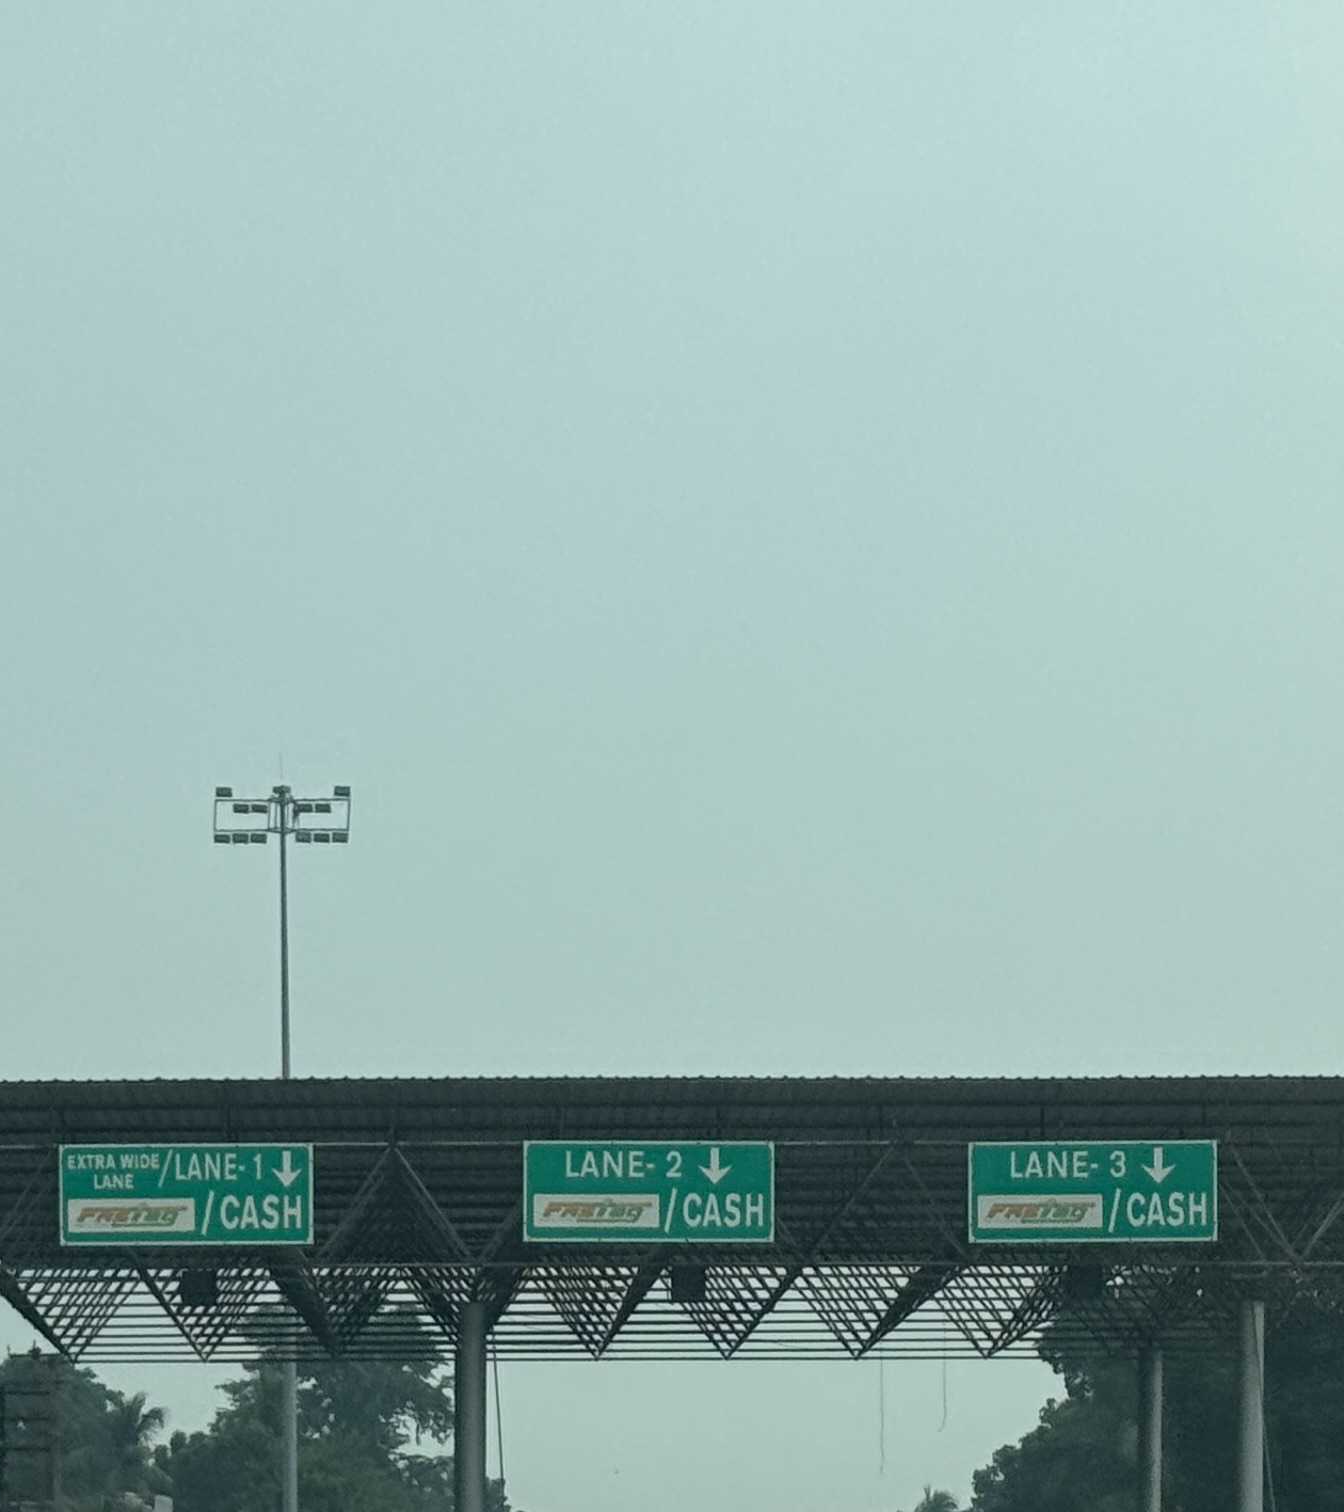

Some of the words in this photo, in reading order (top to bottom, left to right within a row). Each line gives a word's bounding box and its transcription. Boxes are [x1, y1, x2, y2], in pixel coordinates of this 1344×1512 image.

[67, 1153, 116, 1170] EXTRA
[119, 1153, 160, 1170] WIDE
[666, 1150, 683, 1178] 2
[1109, 1150, 1127, 1178] 3
[92, 1174, 134, 1190] LANE
